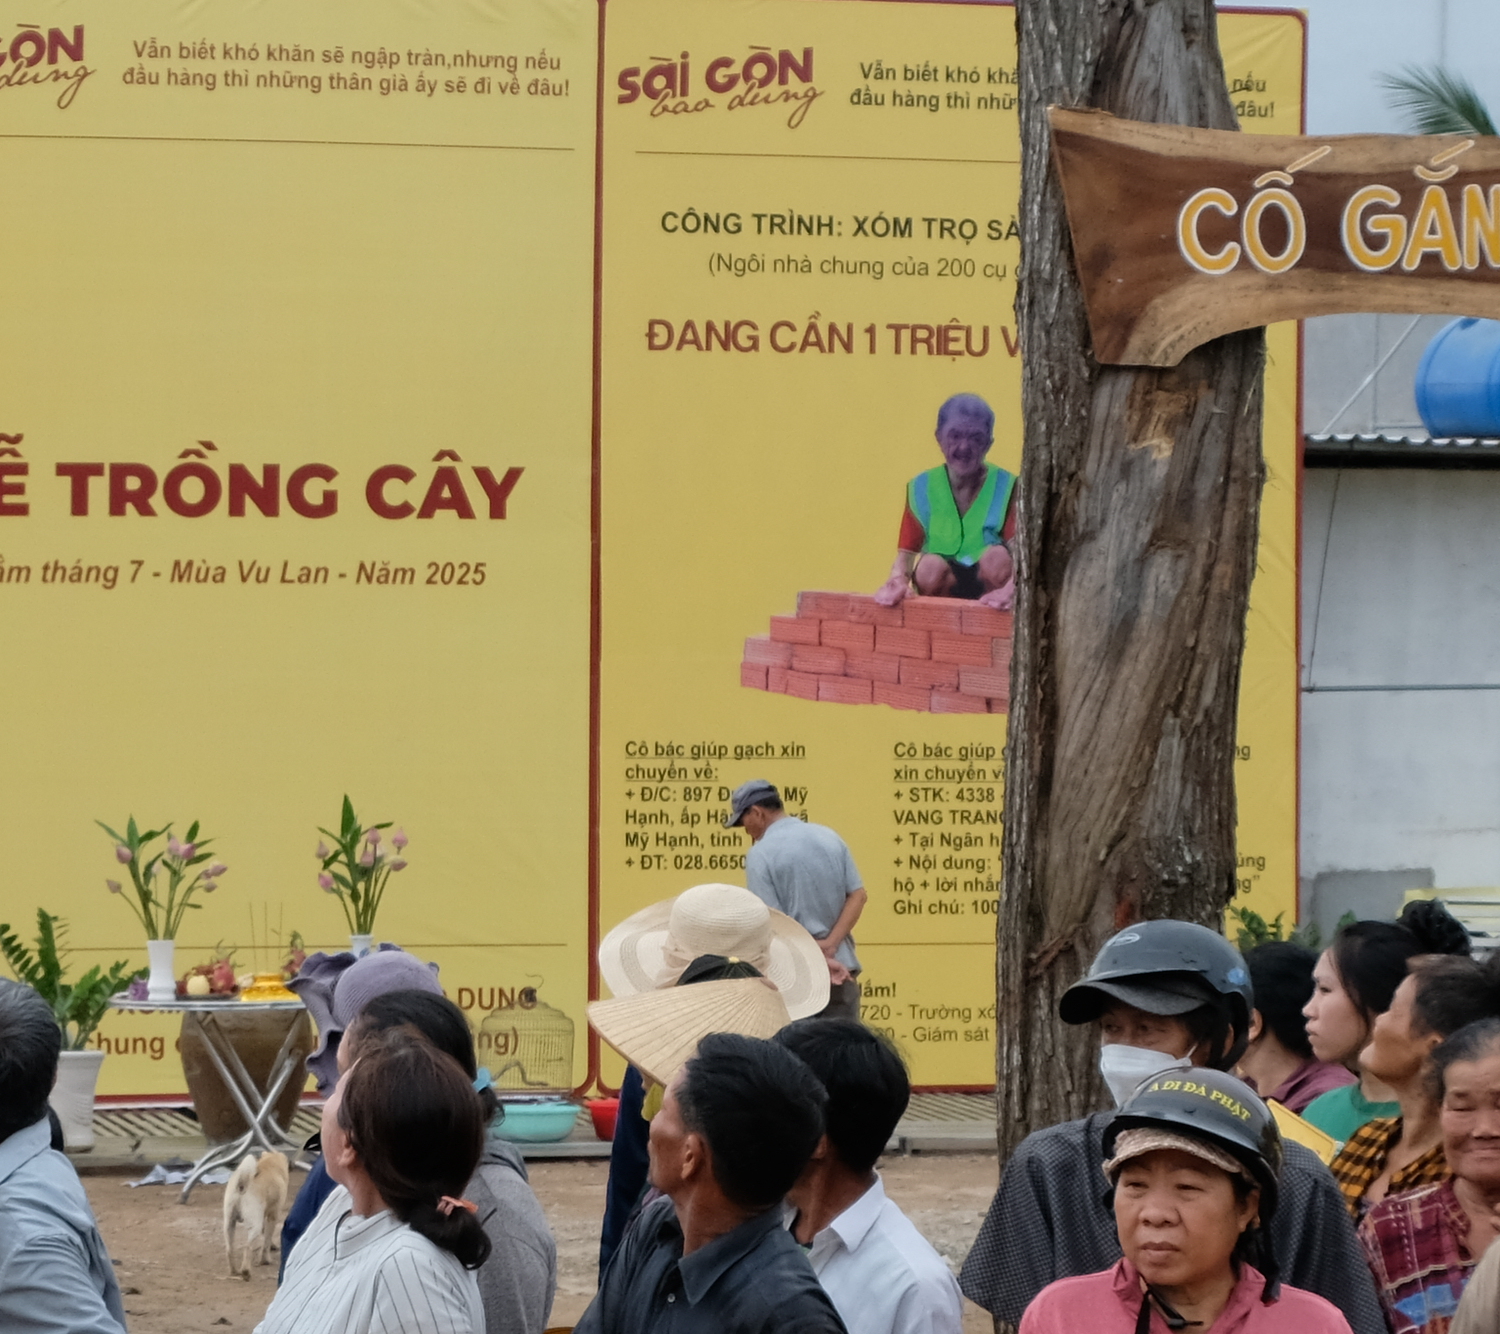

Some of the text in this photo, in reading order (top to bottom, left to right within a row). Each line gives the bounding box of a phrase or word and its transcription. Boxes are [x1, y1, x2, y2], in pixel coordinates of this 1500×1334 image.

[133, 37, 171, 59] Vẫn
[179, 38, 216, 60] biết
[223, 43, 260, 61] khó
[267, 44, 315, 63] khăn
[322, 45, 345, 64] sẽ
[351, 47, 400, 70] ngập
[525, 48, 561, 70] nếu
[122, 63, 569, 98] đầu hàng thì những thân già ấy sẽ đi về đâu!
[860, 59, 1267, 92] Vẫn biết khó khă nếu
[650, 80, 825, 129] bao dung
[850, 85, 885, 106] đầu
[892, 90, 940, 113] hàng
[946, 91, 970, 109] thì
[1177, 145, 1332, 274] CỐ
[661, 207, 742, 235] CÔNG
[752, 209, 843, 237] TRÌNH:
[852, 211, 913, 239] XÓM
[922, 217, 978, 246] TRỌ
[708, 252, 765, 277] (Ngôi
[773, 255, 812, 274] nhà
[820, 256, 884, 280] chung
[891, 256, 929, 276] của
[937, 258, 976, 277] 200
[983, 262, 1007, 282] cụ
[644, 318, 760, 353] ĐANG
[769, 311, 854, 354] CẦN
[864, 322, 877, 354] 1
[886, 318, 990, 362] TRIỆU
[55, 439, 339, 519] TRỒNG
[364, 449, 526, 520] CÂY
[41, 557, 120, 590] tháng
[128, 560, 146, 584] 7
[170, 559, 226, 585] Mùa
[237, 560, 270, 585] Vu
[279, 560, 330, 585] Lan
[356, 560, 416, 586] Năm
[425, 561, 487, 586] 2025
[625, 740, 806, 760] Cô bác giúp gạch xin
[894, 742, 917, 758] Cô
[923, 742, 953, 758] bác
[958, 742, 996, 761] giúp
[625, 760, 719, 783] chuyển về:
[894, 765, 918, 780] xin
[924, 760, 986, 784] chuyển
[640, 786, 677, 803] Đ/C:
[683, 787, 712, 802] 897
[784, 786, 808, 806] Mỹ
[909, 787, 995, 803] STK: 4338
[625, 809, 675, 829] Hạnh,
[680, 806, 701, 828] ấp
[893, 809, 943, 826] VANG
[625, 831, 649, 851] Mỹ
[655, 832, 705, 851] Hạnh,
[710, 831, 743, 847] tỉnh
[909, 832, 934, 851] Tại
[940, 832, 984, 851] Ngân
[640, 855, 667, 870] ĐT:
[909, 855, 937, 874] Nội
[942, 855, 991, 874] dung:
[893, 877, 915, 896] hộ
[936, 877, 957, 892] lời
[893, 899, 922, 915] Ghi
[928, 899, 965, 915] chú:
[908, 1004, 972, 1023] Trường
[913, 1027, 989, 1042] Giám sát
